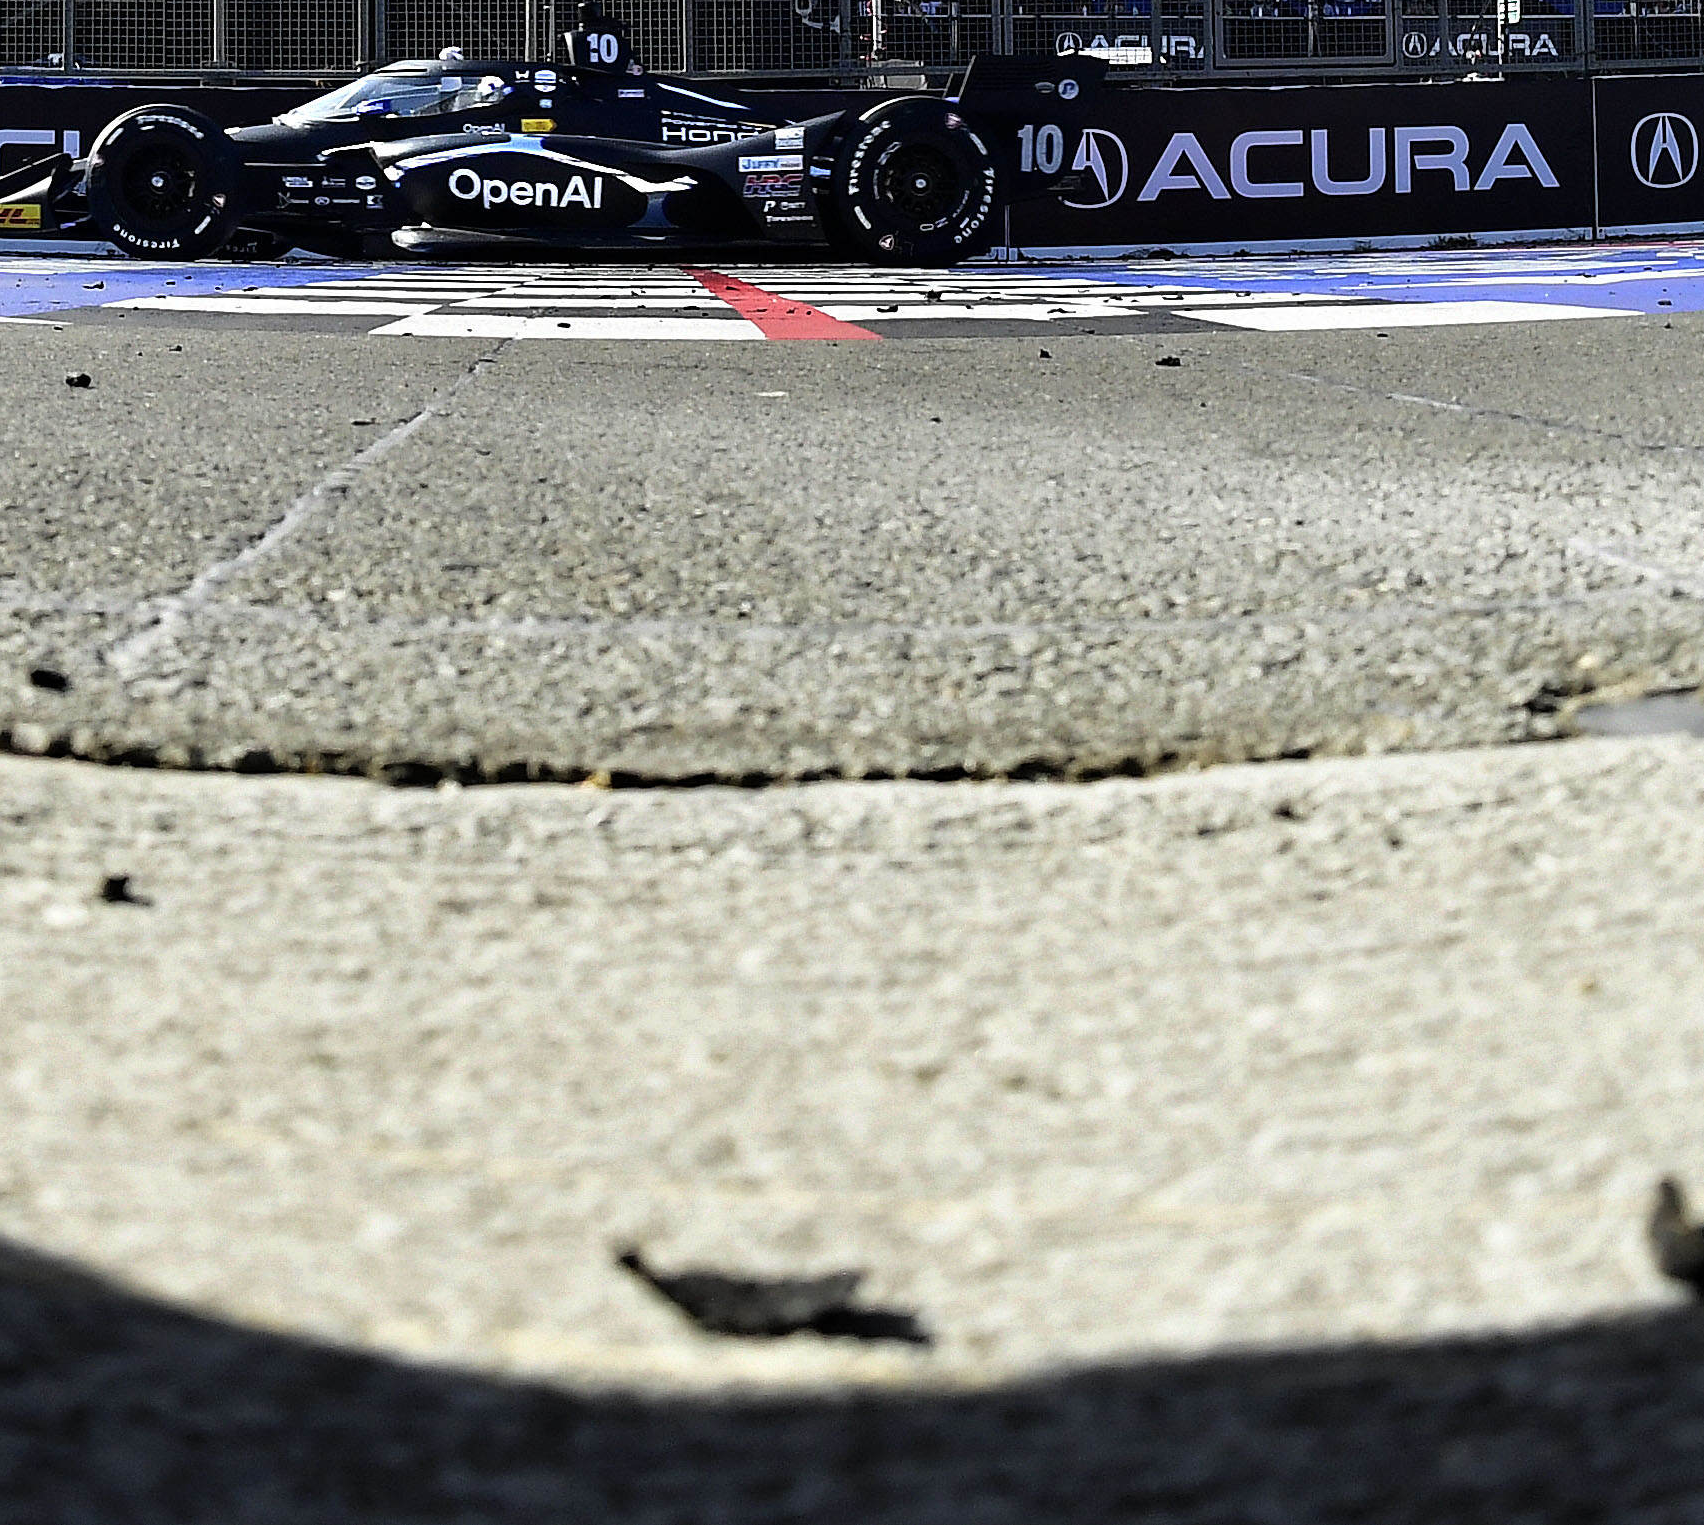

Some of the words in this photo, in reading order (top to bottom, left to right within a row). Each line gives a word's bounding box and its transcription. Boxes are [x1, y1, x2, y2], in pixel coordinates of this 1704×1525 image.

[587, 34, 618, 63] 10
[662, 126, 759, 141] Hon
[1018, 125, 1063, 173] 10
[1137, 124, 1559, 201] ACURA
[449, 168, 602, 209] OpenAI
[113, 224, 180, 249] Firestone
